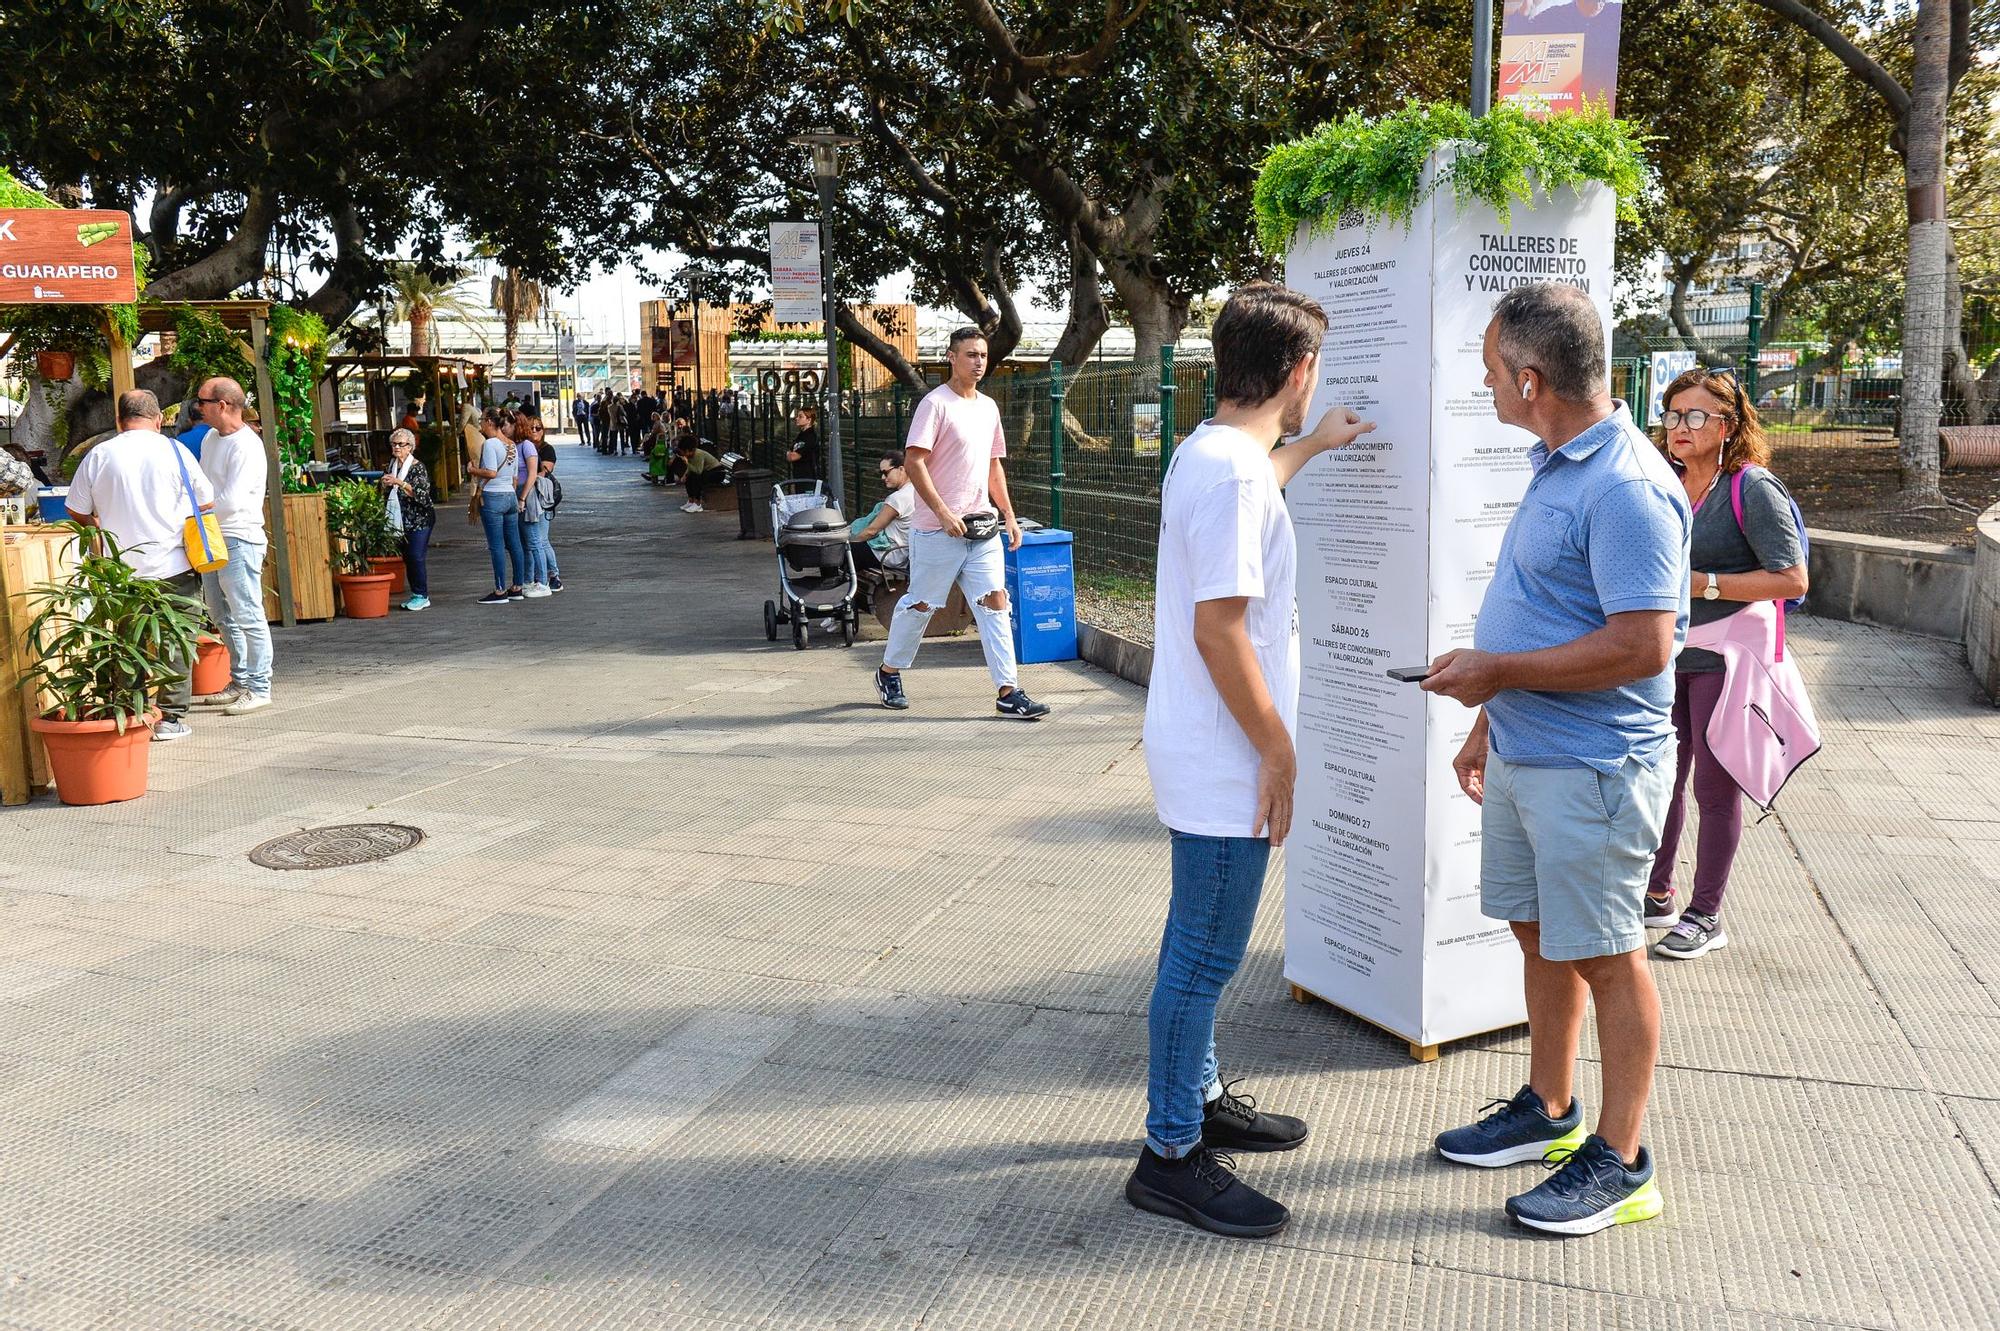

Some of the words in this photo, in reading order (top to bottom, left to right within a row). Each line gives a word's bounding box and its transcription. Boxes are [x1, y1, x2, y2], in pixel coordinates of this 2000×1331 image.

[1335, 247, 1360, 260] JUEVES
[1362, 245, 1370, 255] 24
[1480, 234, 1555, 254] TALLERES
[1559, 238, 1577, 254] DE
[2, 265, 117, 279] GUARAPERO
[1314, 269, 1339, 279] TALLERES
[1340, 267, 1347, 276] DE
[1348, 260, 1396, 275] CONOCIMIENTO
[1470, 254, 1586, 275] CONOCIMIENTO
[1334, 275, 1378, 288] VALORIZACIÓN
[1465, 275, 1474, 291] Y
[1479, 274, 1590, 294] VALORIÓN
[1326, 377, 1349, 385] ESPACIO
[1350, 375, 1379, 384] CULTURAL
[1349, 442, 1393, 451] CONOCIMIENTO
[1334, 453, 1376, 462] VALORIZACIÓN
[1325, 576, 1348, 586] ESPACIO
[1349, 578, 1378, 589] CULTURAL
[1332, 622, 1359, 636] SÁBADO
[1361, 628, 1370, 638] 26
[1313, 638, 1338, 649] TALLERES
[1348, 644, 1391, 658] CONOCIMIENTO
[1333, 653, 1373, 666] VALORIZACIÓN
[1325, 762, 1347, 774] ESPACIO
[1348, 768, 1376, 783] CULTURAL
[1329, 809, 1360, 826] DOMINGO
[1362, 819, 1371, 829] 27
[1312, 820, 1337, 834] TALLERES
[1338, 829, 1346, 837] DE
[1346, 831, 1390, 852] CONOCIMIENTO
[1332, 837, 1372, 856] VALORIZACIÓN
[1436, 938, 1453, 946] TALLER
[1455, 934, 1475, 943] ADULTOS
[1324, 937, 1346, 952] ESPACIO
[1347, 944, 1376, 965] CULTURAL
